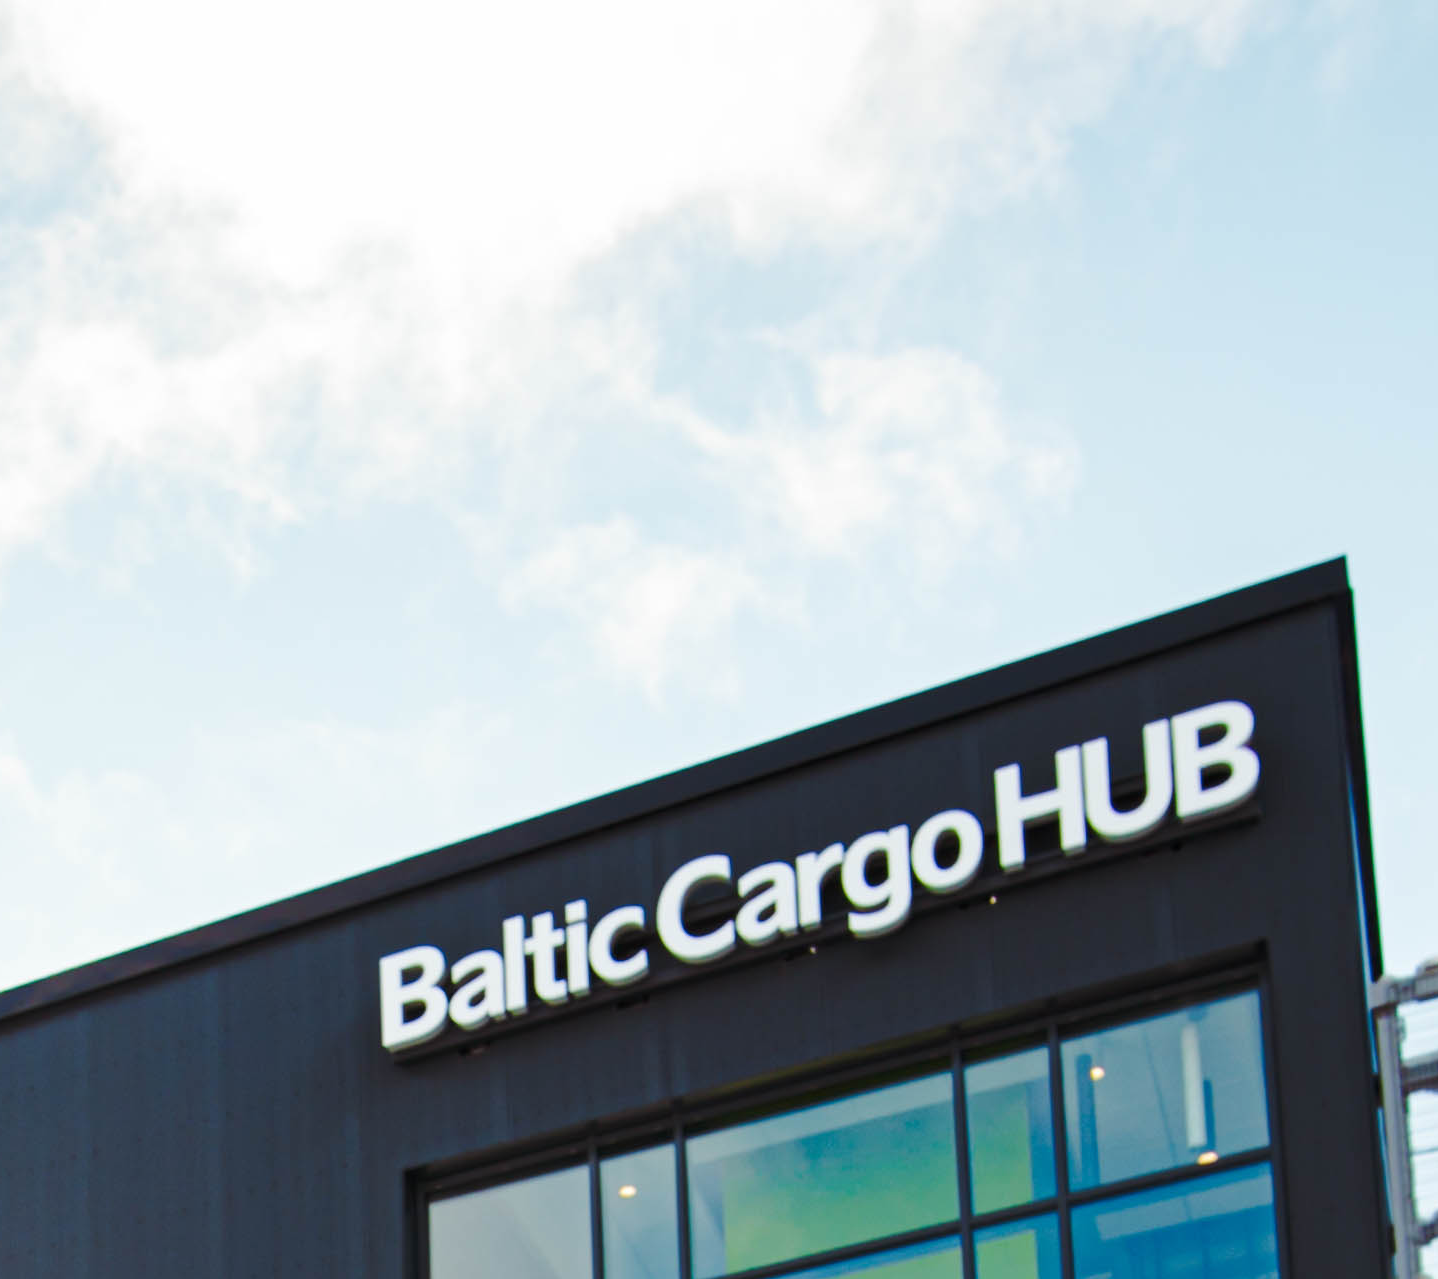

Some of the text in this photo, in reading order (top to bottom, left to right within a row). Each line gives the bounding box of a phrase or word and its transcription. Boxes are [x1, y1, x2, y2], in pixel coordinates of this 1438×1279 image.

[379, 699, 1261, 1053] Baltic Cargo HUB
